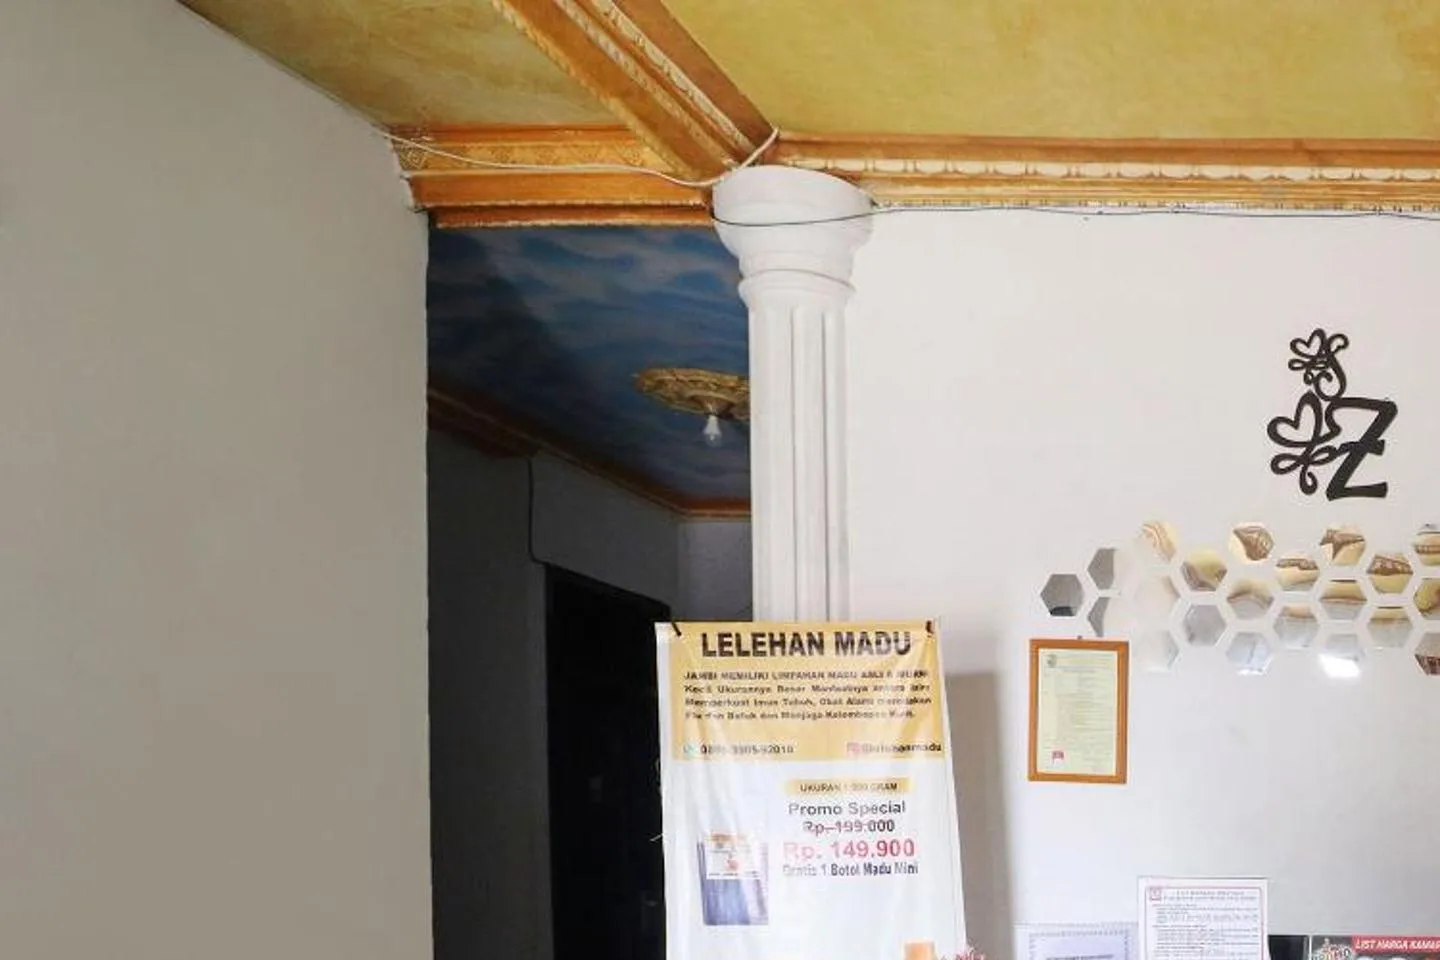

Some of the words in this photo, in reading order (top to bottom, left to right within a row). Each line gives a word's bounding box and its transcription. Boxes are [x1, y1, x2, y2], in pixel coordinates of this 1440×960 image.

[701, 632, 825, 657] LELEHAN
[834, 631, 911, 657] MADU
[788, 803, 842, 817] Promo
[848, 800, 907, 816] Special
[783, 841, 823, 860] Rp.
[832, 839, 916, 858] 149.900
[831, 863, 860, 877] Botol
[863, 863, 892, 876] Madu
[895, 862, 919, 875] Mini
[1355, 941, 1377, 950] LIST
